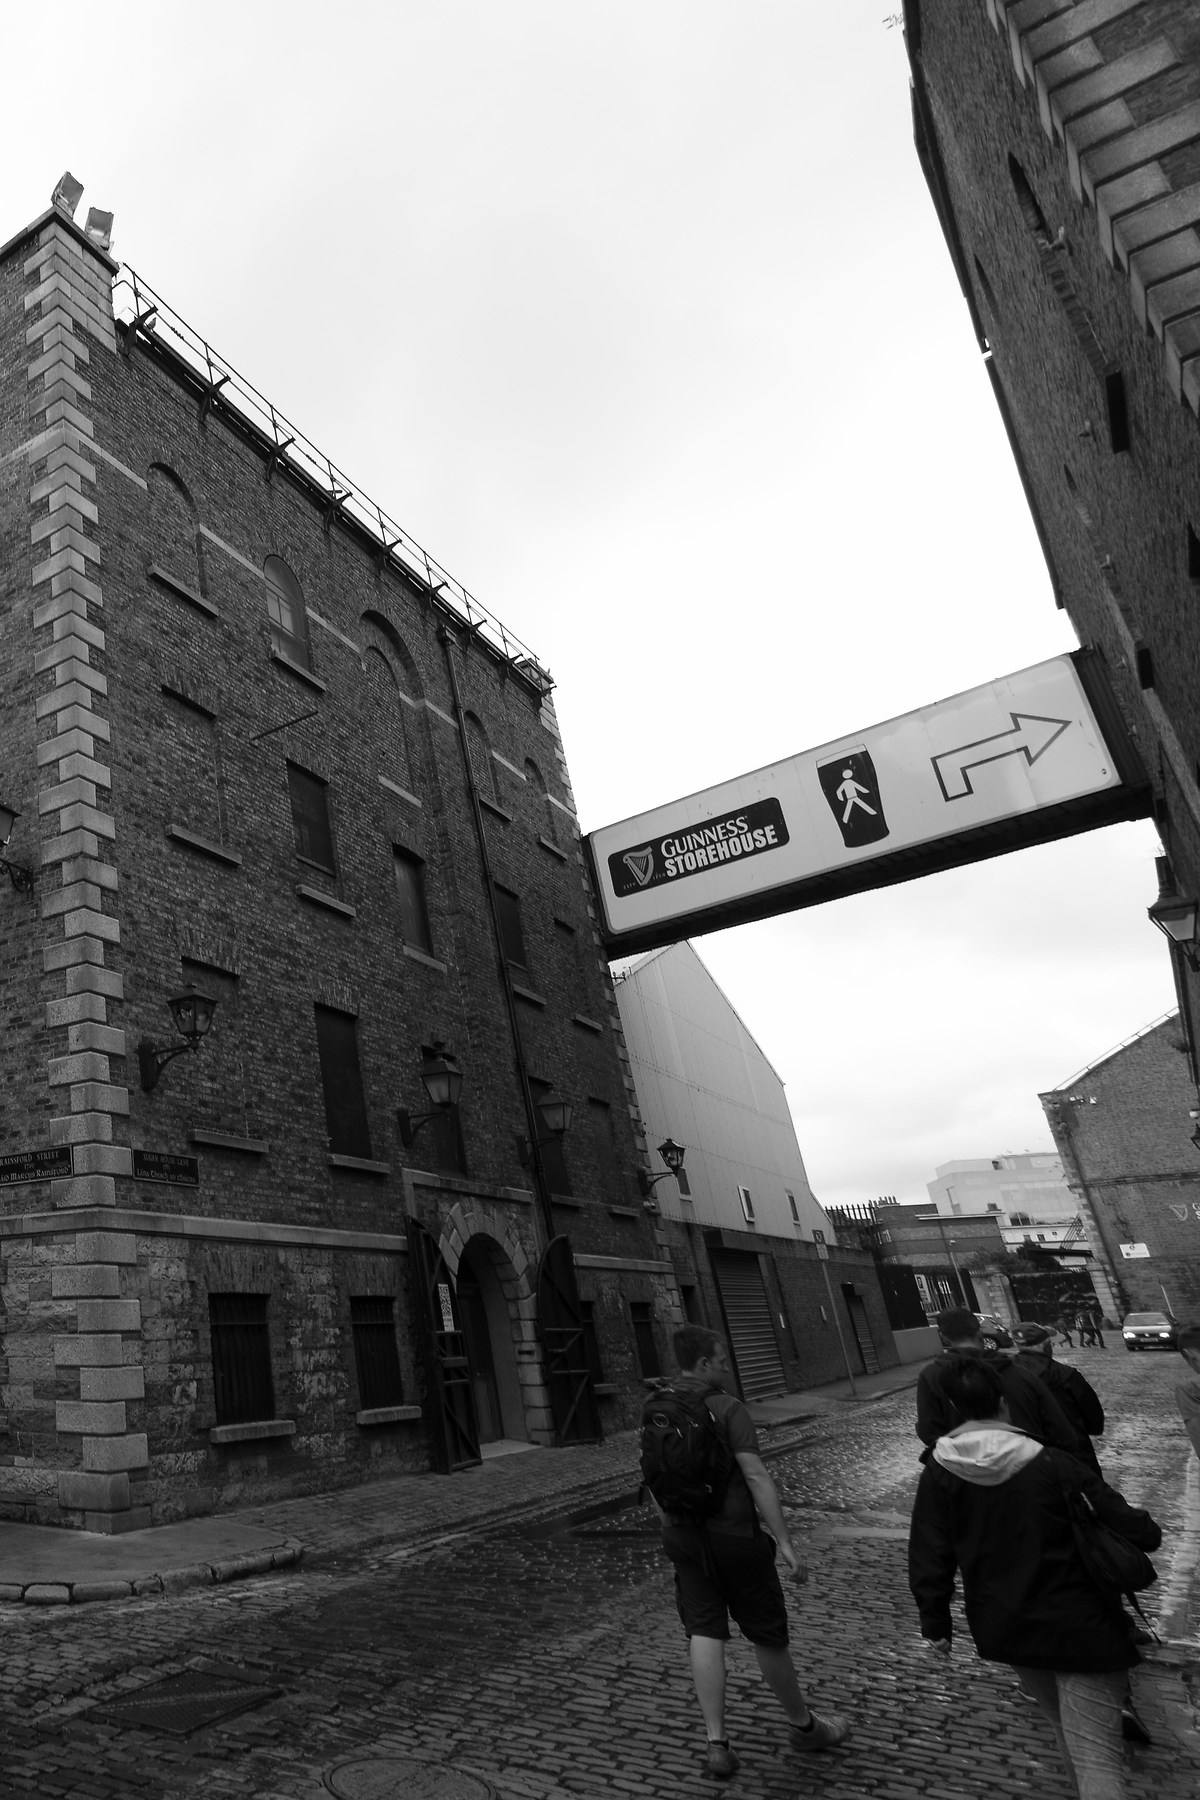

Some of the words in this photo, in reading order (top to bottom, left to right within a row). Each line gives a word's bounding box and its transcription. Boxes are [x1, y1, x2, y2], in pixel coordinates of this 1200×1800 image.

[661, 816, 748, 858] GUINNESS
[665, 824, 778, 877] STOREHOUSE
[0, 1153, 33, 1166] RAINSFORD
[36, 1151, 59, 1161] STREET
